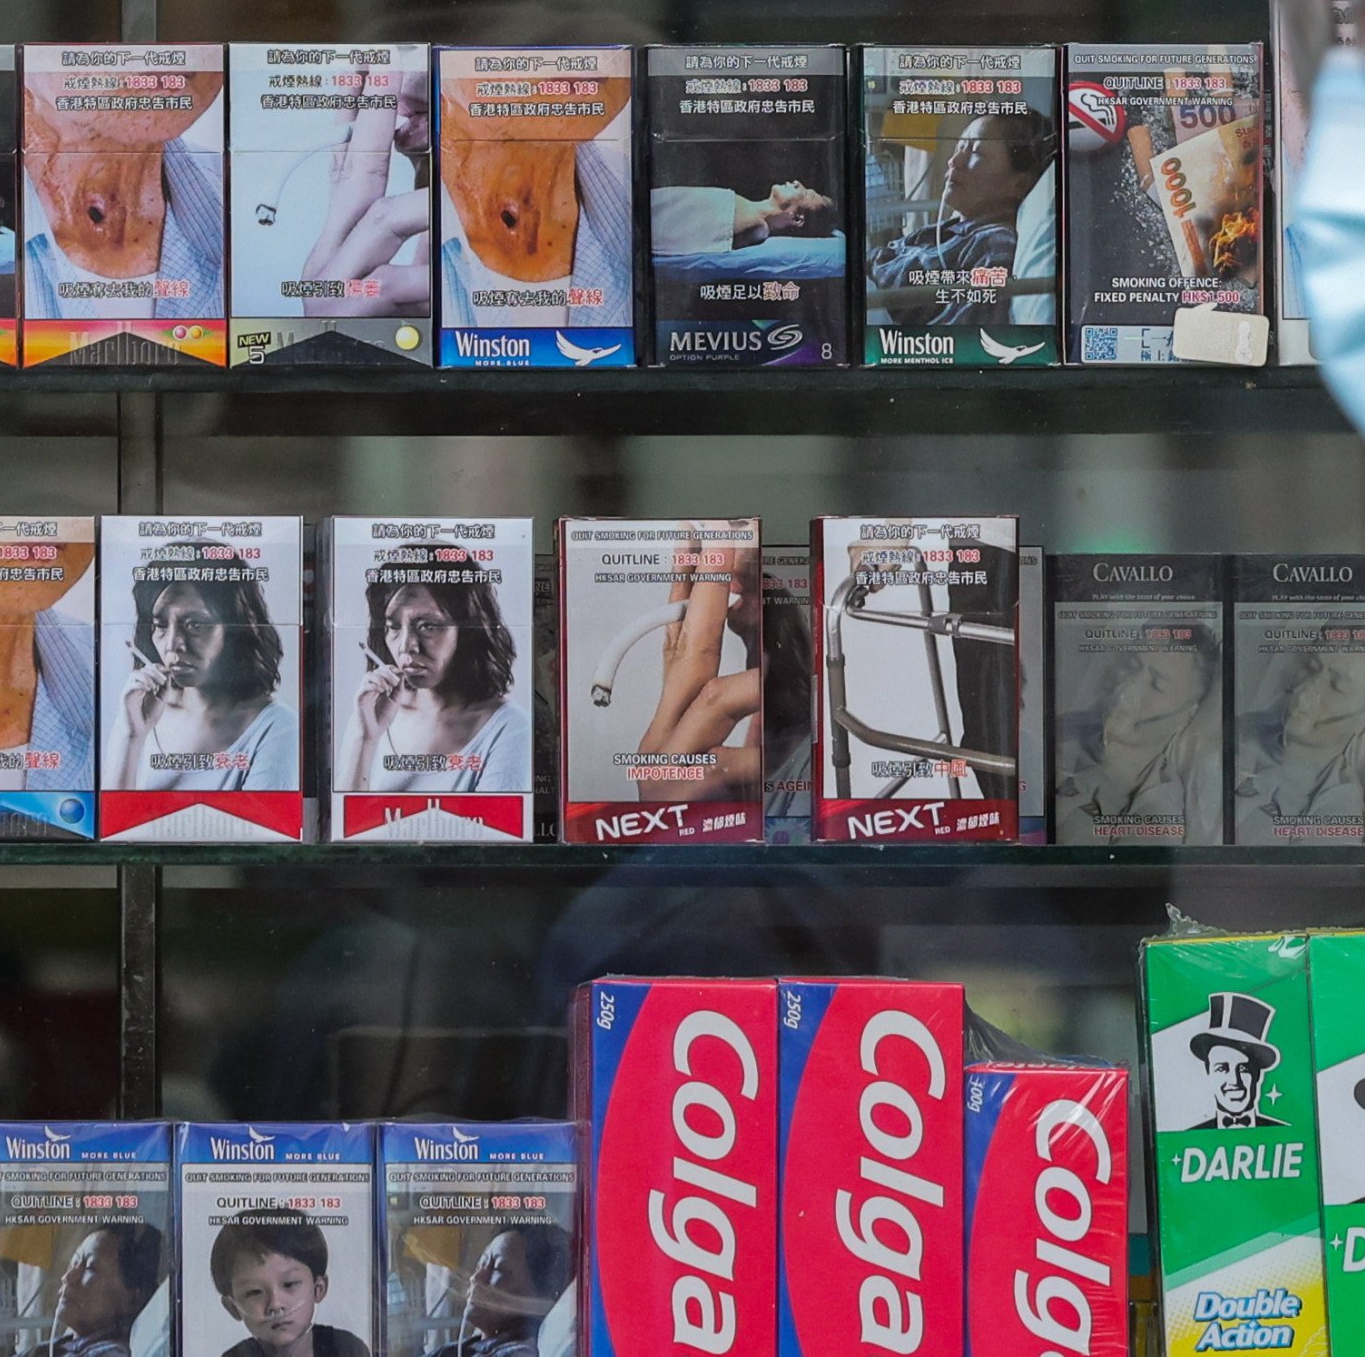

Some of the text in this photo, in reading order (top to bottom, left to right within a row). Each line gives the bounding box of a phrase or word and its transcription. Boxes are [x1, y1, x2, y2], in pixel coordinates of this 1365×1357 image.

[1112, 278, 1165, 288] SMOKING
[1094, 292, 1126, 303] FIXED
[1129, 292, 1180, 303] PENALTY
[239, 332, 271, 347] NEW
[456, 331, 531, 359] Winston
[670, 330, 763, 354] MEVIUS
[821, 342, 832, 360] 8
[879, 328, 955, 356] Winston
[601, 553, 724, 567] QUITLINE 1833 183
[1092, 562, 1173, 582] CAVALLO
[1273, 563, 1353, 583] CAVALLO
[613, 752, 717, 766] SMOKING CAUSES
[626, 765, 704, 781] IMPOTENCE
[595, 804, 688, 840] NEXT
[847, 801, 946, 840] NEXT
[1093, 826, 1184, 836] HEART DISEASE
[598, 991, 615, 1031] 250g
[784, 992, 801, 1029] 250g
[6, 1136, 71, 1160] Winston
[210, 1137, 275, 1161] Winston
[414, 1137, 479, 1161] Winston
[1181, 1143, 1303, 1183] DARLIE
[1194, 1288, 1302, 1321] Double
[1195, 1322, 1294, 1352] Action
